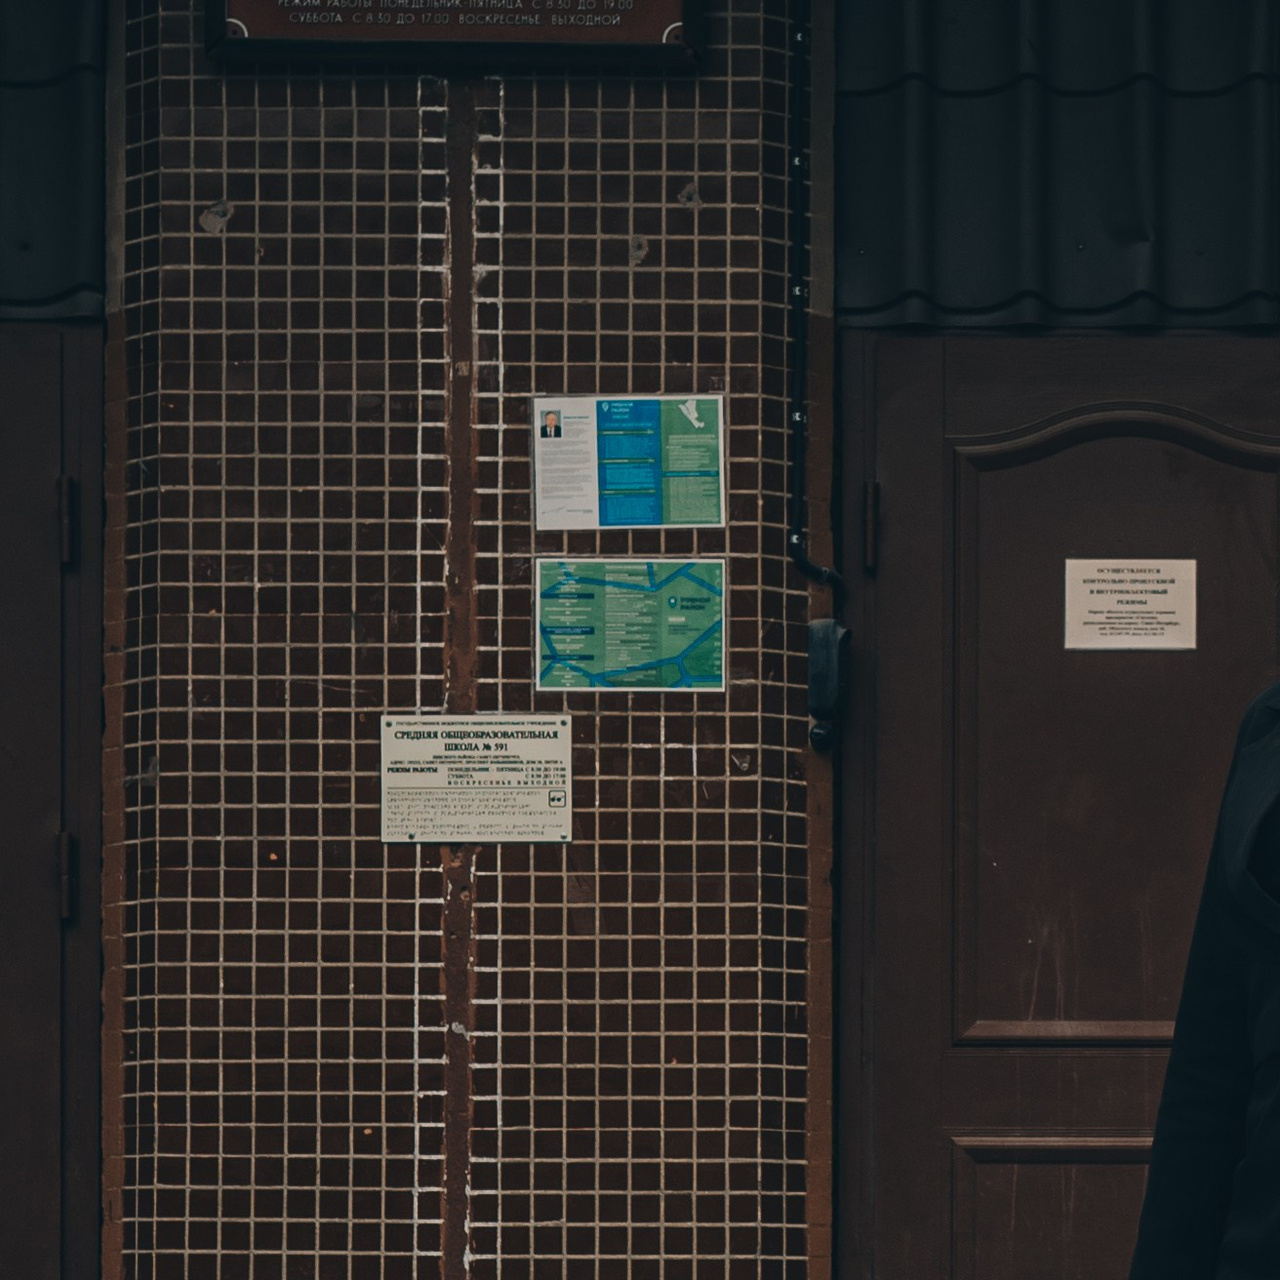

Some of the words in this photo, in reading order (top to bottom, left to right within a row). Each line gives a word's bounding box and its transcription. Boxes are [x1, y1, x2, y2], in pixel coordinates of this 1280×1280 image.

[352, 12, 361, 24] С
[396, 12, 416, 25] ДО
[551, 11, 622, 25] ВЫХОДНОЙ
[394, 731, 438, 741] СРЕДНЯЯ
[441, 731, 558, 741] ОБЩЕОБРАЗОВАТЕЛЬНАЯ
[444, 743, 480, 751] ШКОЛА
[482, 743, 492, 751] №
[495, 743, 508, 751] 591
